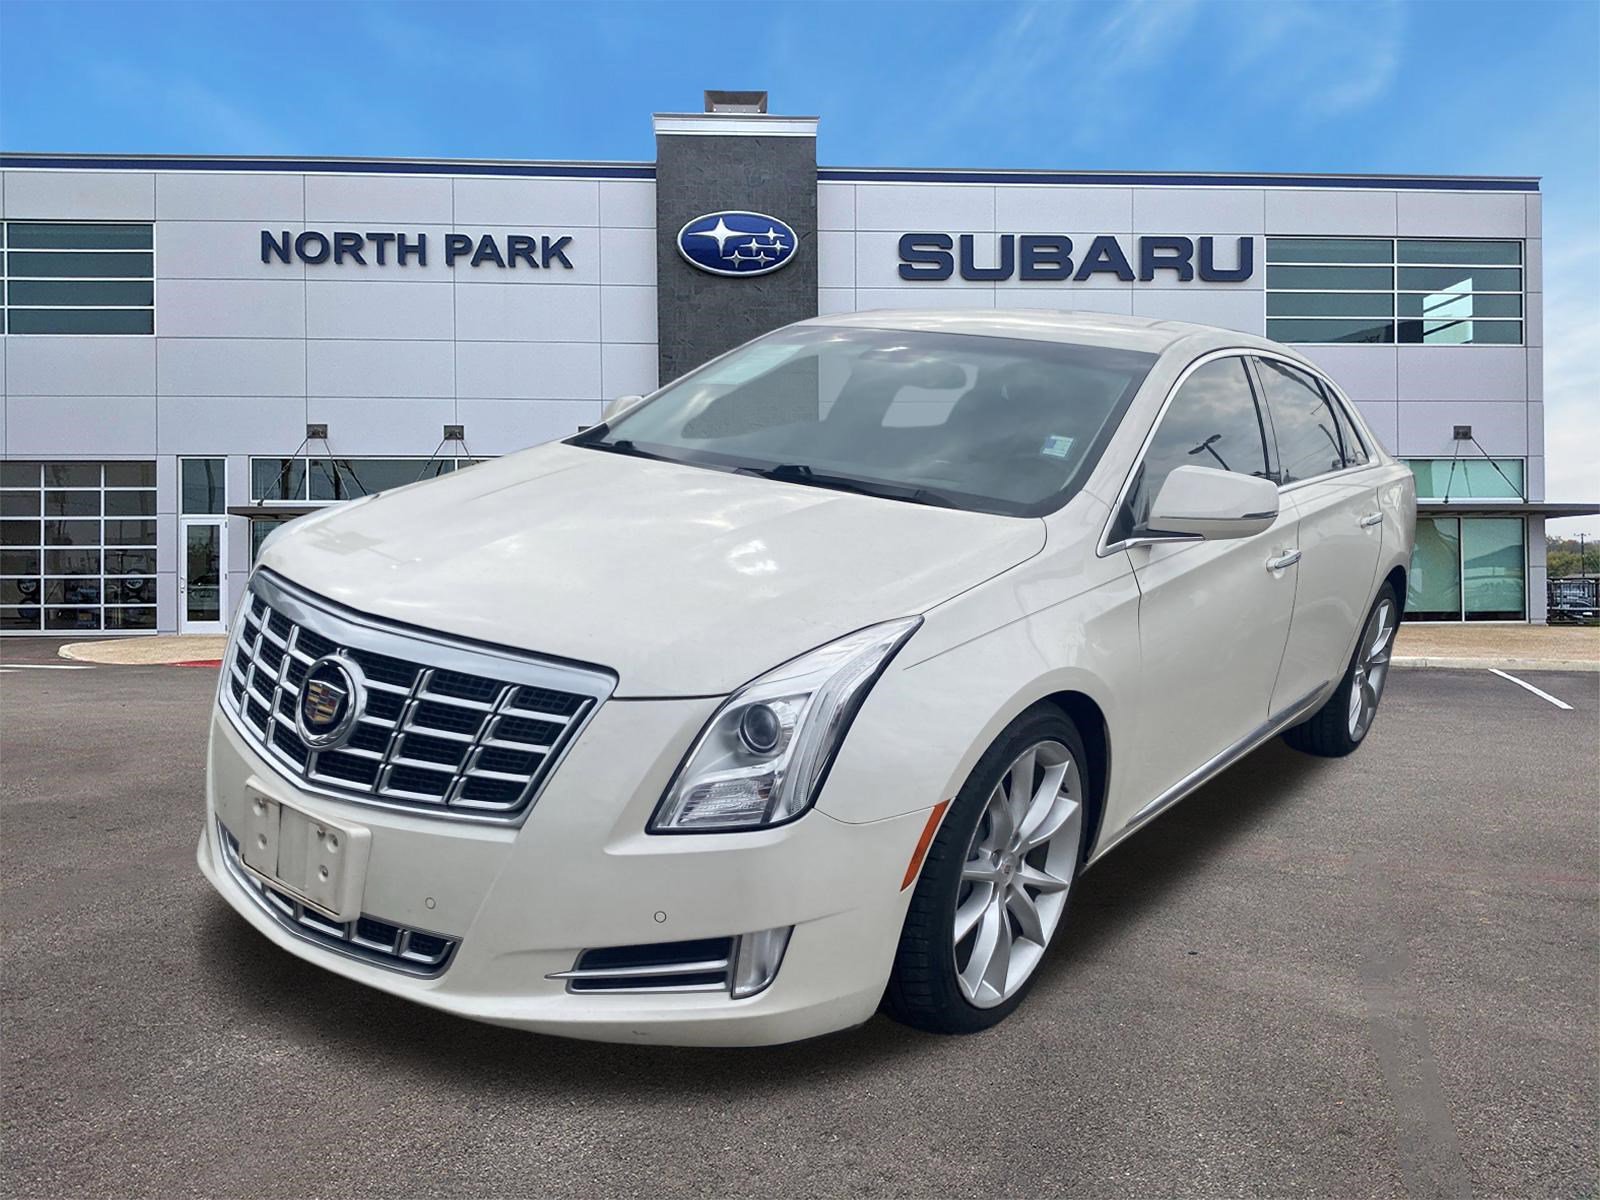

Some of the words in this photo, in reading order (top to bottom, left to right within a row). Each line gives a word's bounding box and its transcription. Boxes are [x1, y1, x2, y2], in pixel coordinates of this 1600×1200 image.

[260, 230, 427, 266] NORTH
[444, 233, 574, 270] PARK
[898, 232, 1254, 282] SUBARU
